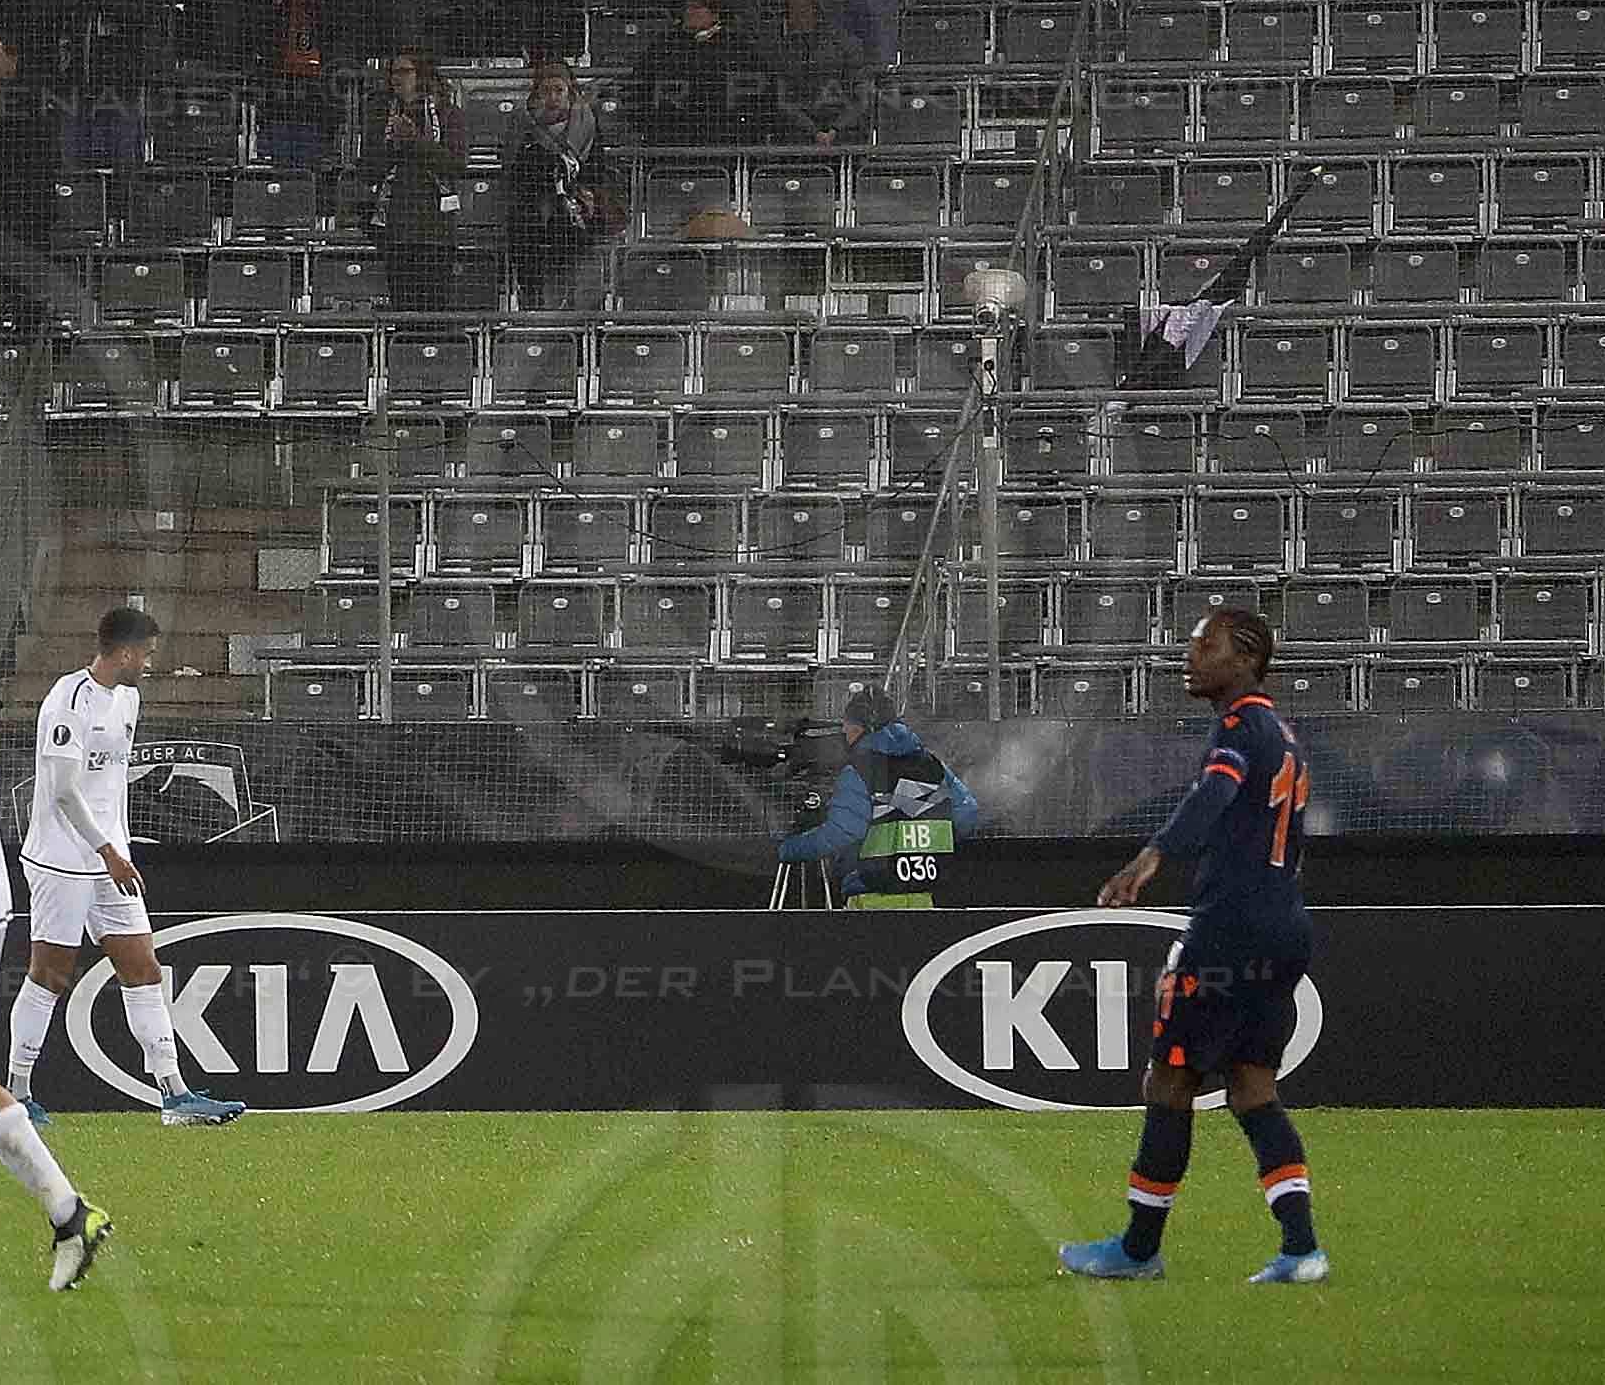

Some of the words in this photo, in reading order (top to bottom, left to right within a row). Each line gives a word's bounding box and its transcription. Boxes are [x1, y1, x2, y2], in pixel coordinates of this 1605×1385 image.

[896, 855, 937, 881] 036
[902, 824, 931, 848] HB
[155, 963, 411, 1073] KIA
[975, 960, 1131, 1071] KI
